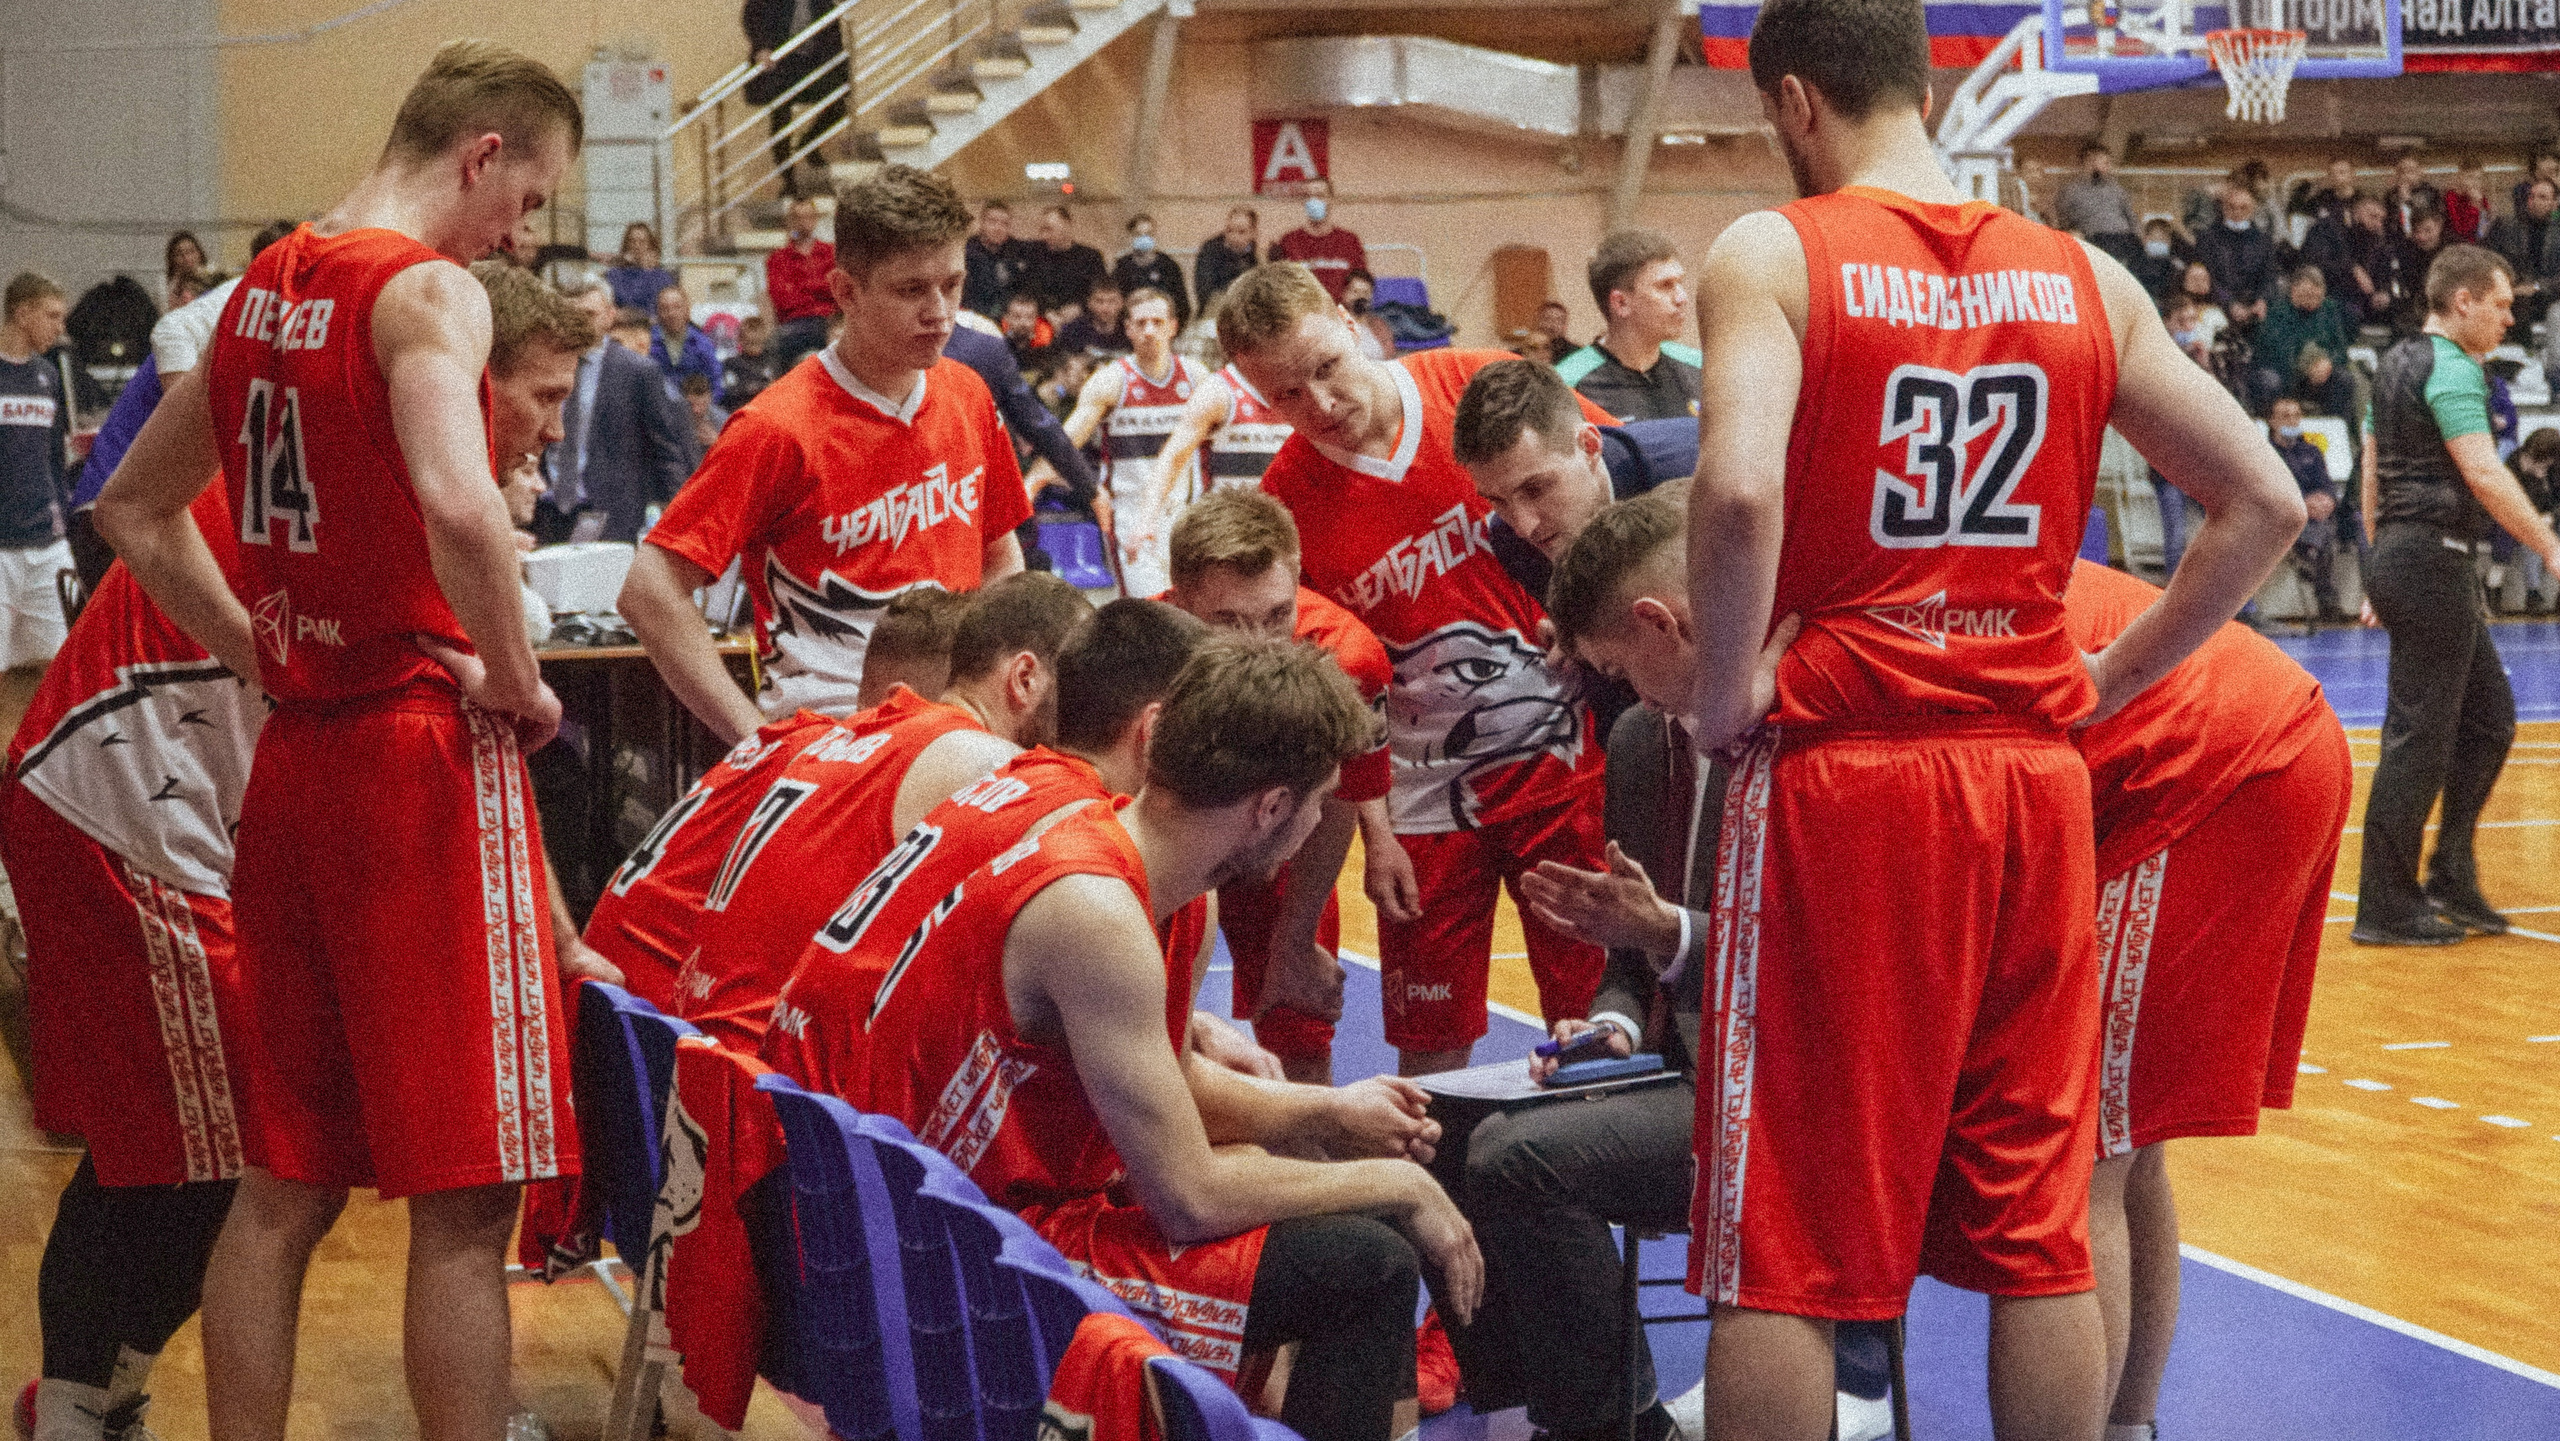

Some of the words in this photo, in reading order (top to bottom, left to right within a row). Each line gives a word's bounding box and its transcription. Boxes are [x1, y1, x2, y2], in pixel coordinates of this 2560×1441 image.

[1841, 263, 2078, 330] СИДЕЛЬНИКОВ
[239, 378, 320, 554] 14
[1870, 362, 2050, 549] 32
[1943, 608, 2017, 637] РМК
